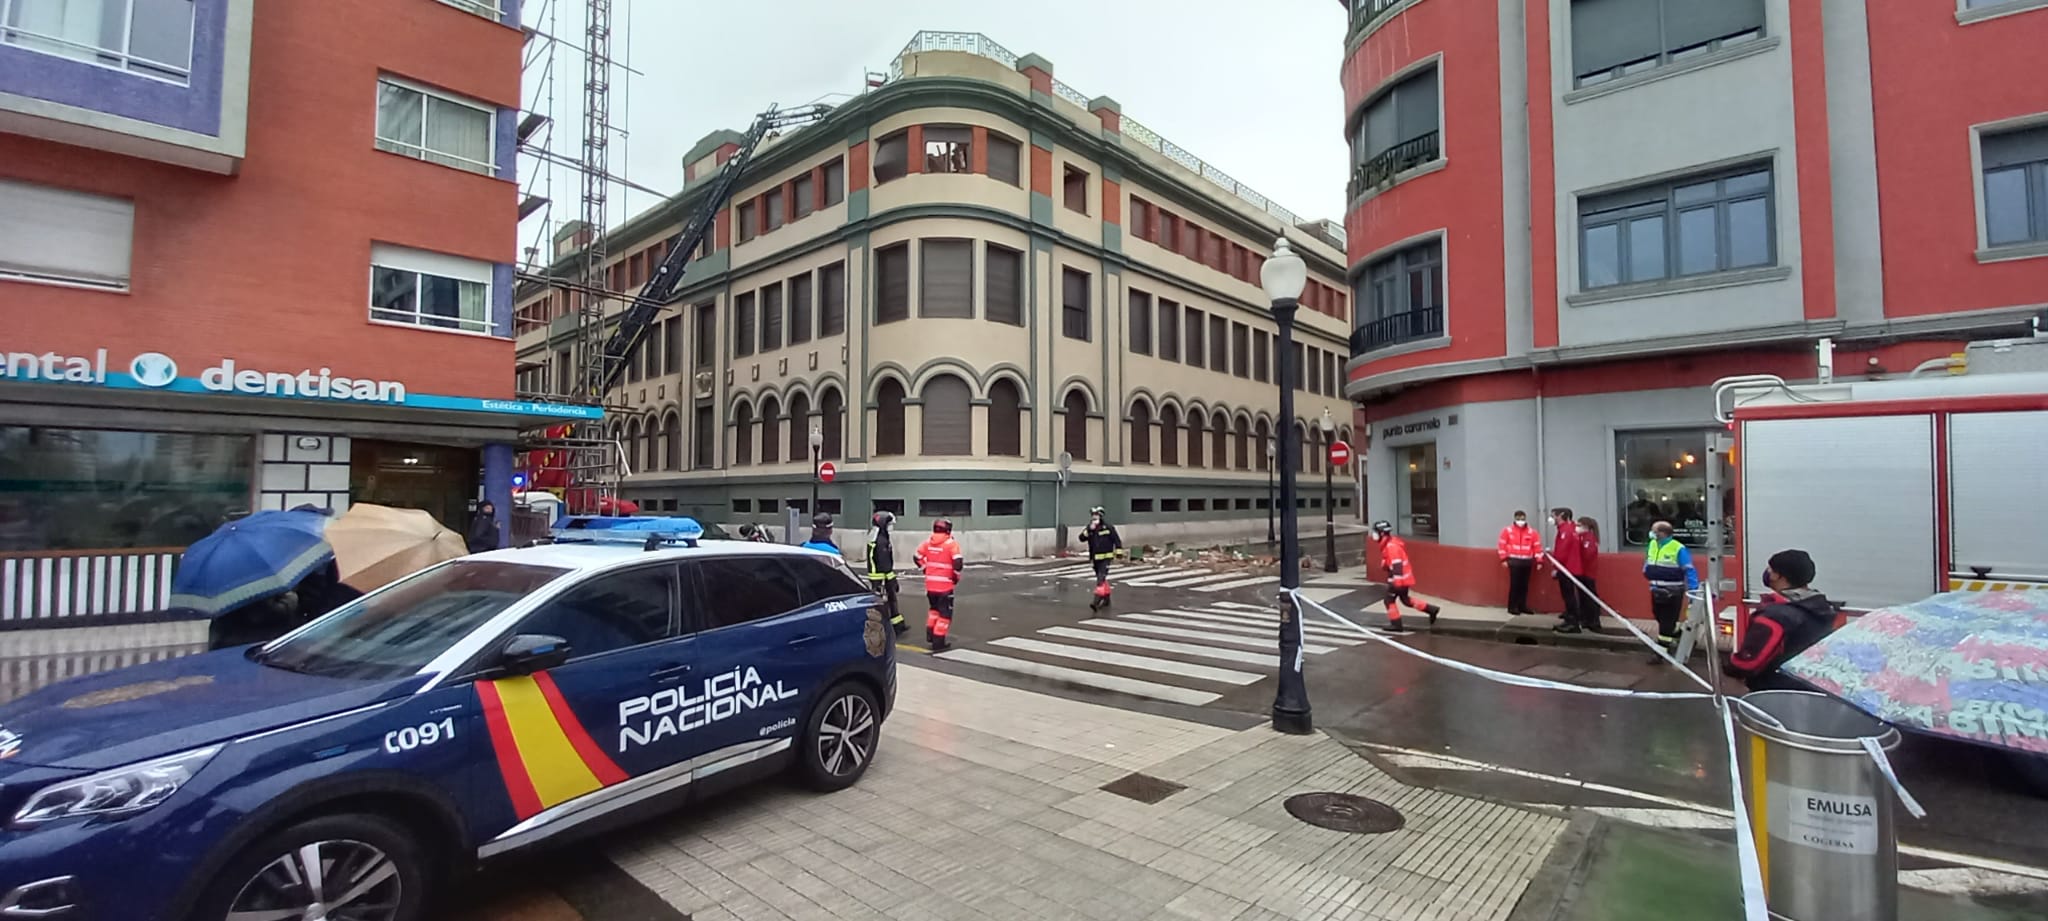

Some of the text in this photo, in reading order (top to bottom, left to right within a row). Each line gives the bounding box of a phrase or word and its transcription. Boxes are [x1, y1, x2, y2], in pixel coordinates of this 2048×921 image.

[0, 348, 107, 383] ntal
[201, 358, 405, 402] dentisan
[619, 665, 762, 726] POLICÍA
[619, 680, 799, 753] NACIONAL
[1807, 797, 1873, 817] EMULSA
